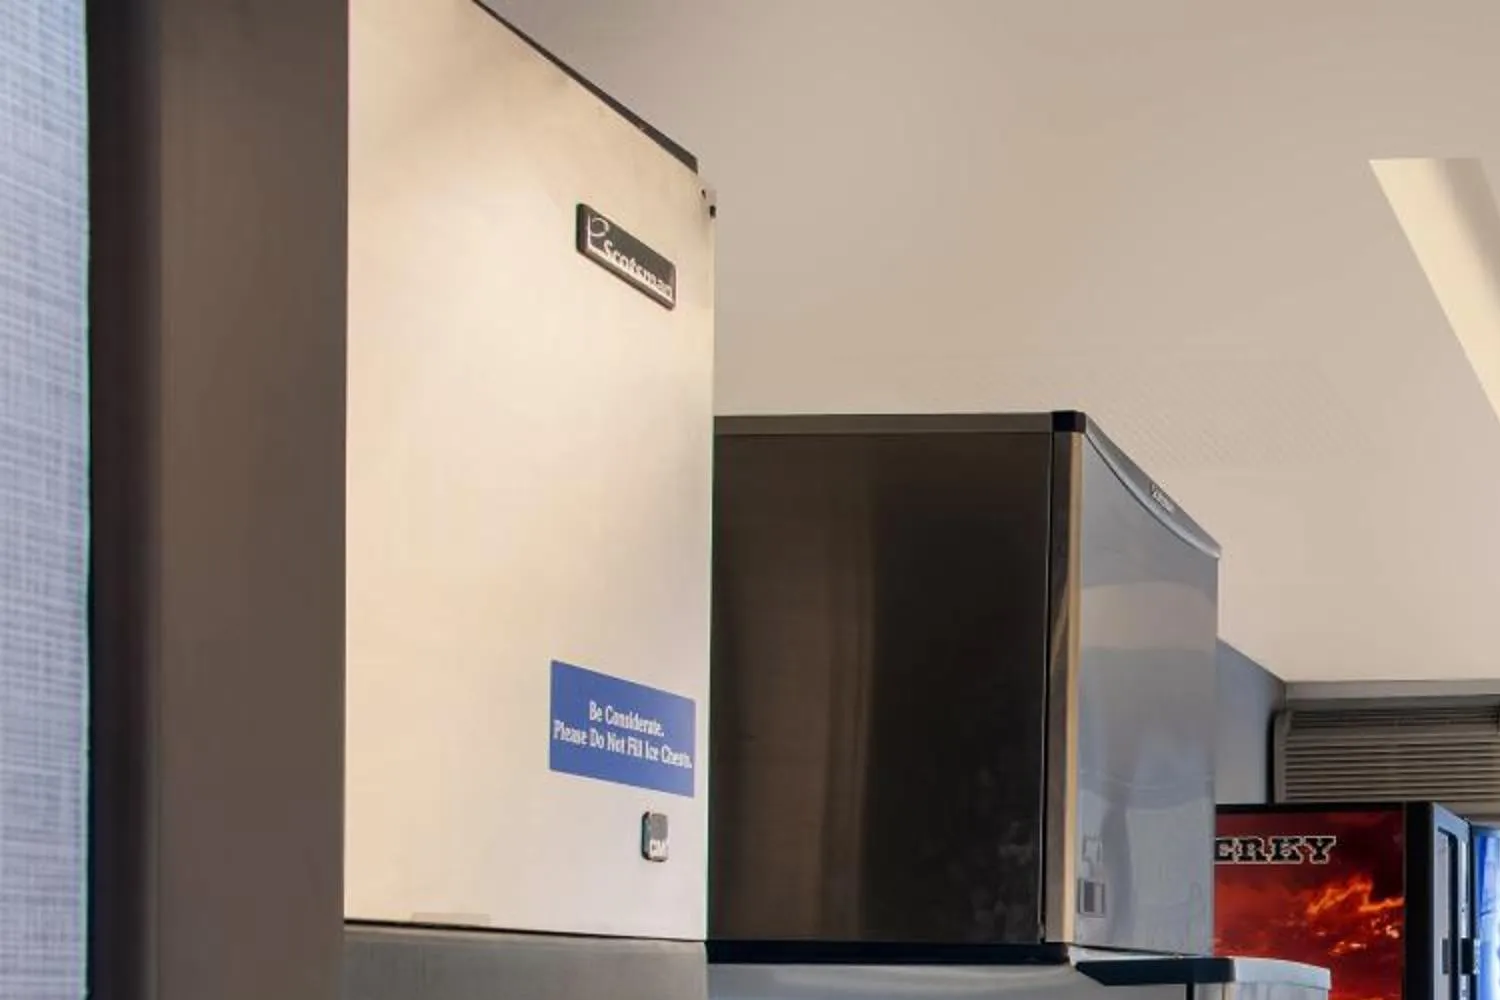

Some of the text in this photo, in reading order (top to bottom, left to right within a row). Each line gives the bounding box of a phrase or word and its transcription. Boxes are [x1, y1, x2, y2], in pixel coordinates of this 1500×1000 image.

[602, 239, 674, 300] Scotsman
[588, 700, 603, 722] Be
[553, 719, 588, 746] Please
[589, 728, 605, 749] Do
[607, 732, 625, 754] Not
[627, 736, 643, 758] Fill
[645, 740, 658, 761] Ice
[1214, 835, 1337, 865] ERKY
